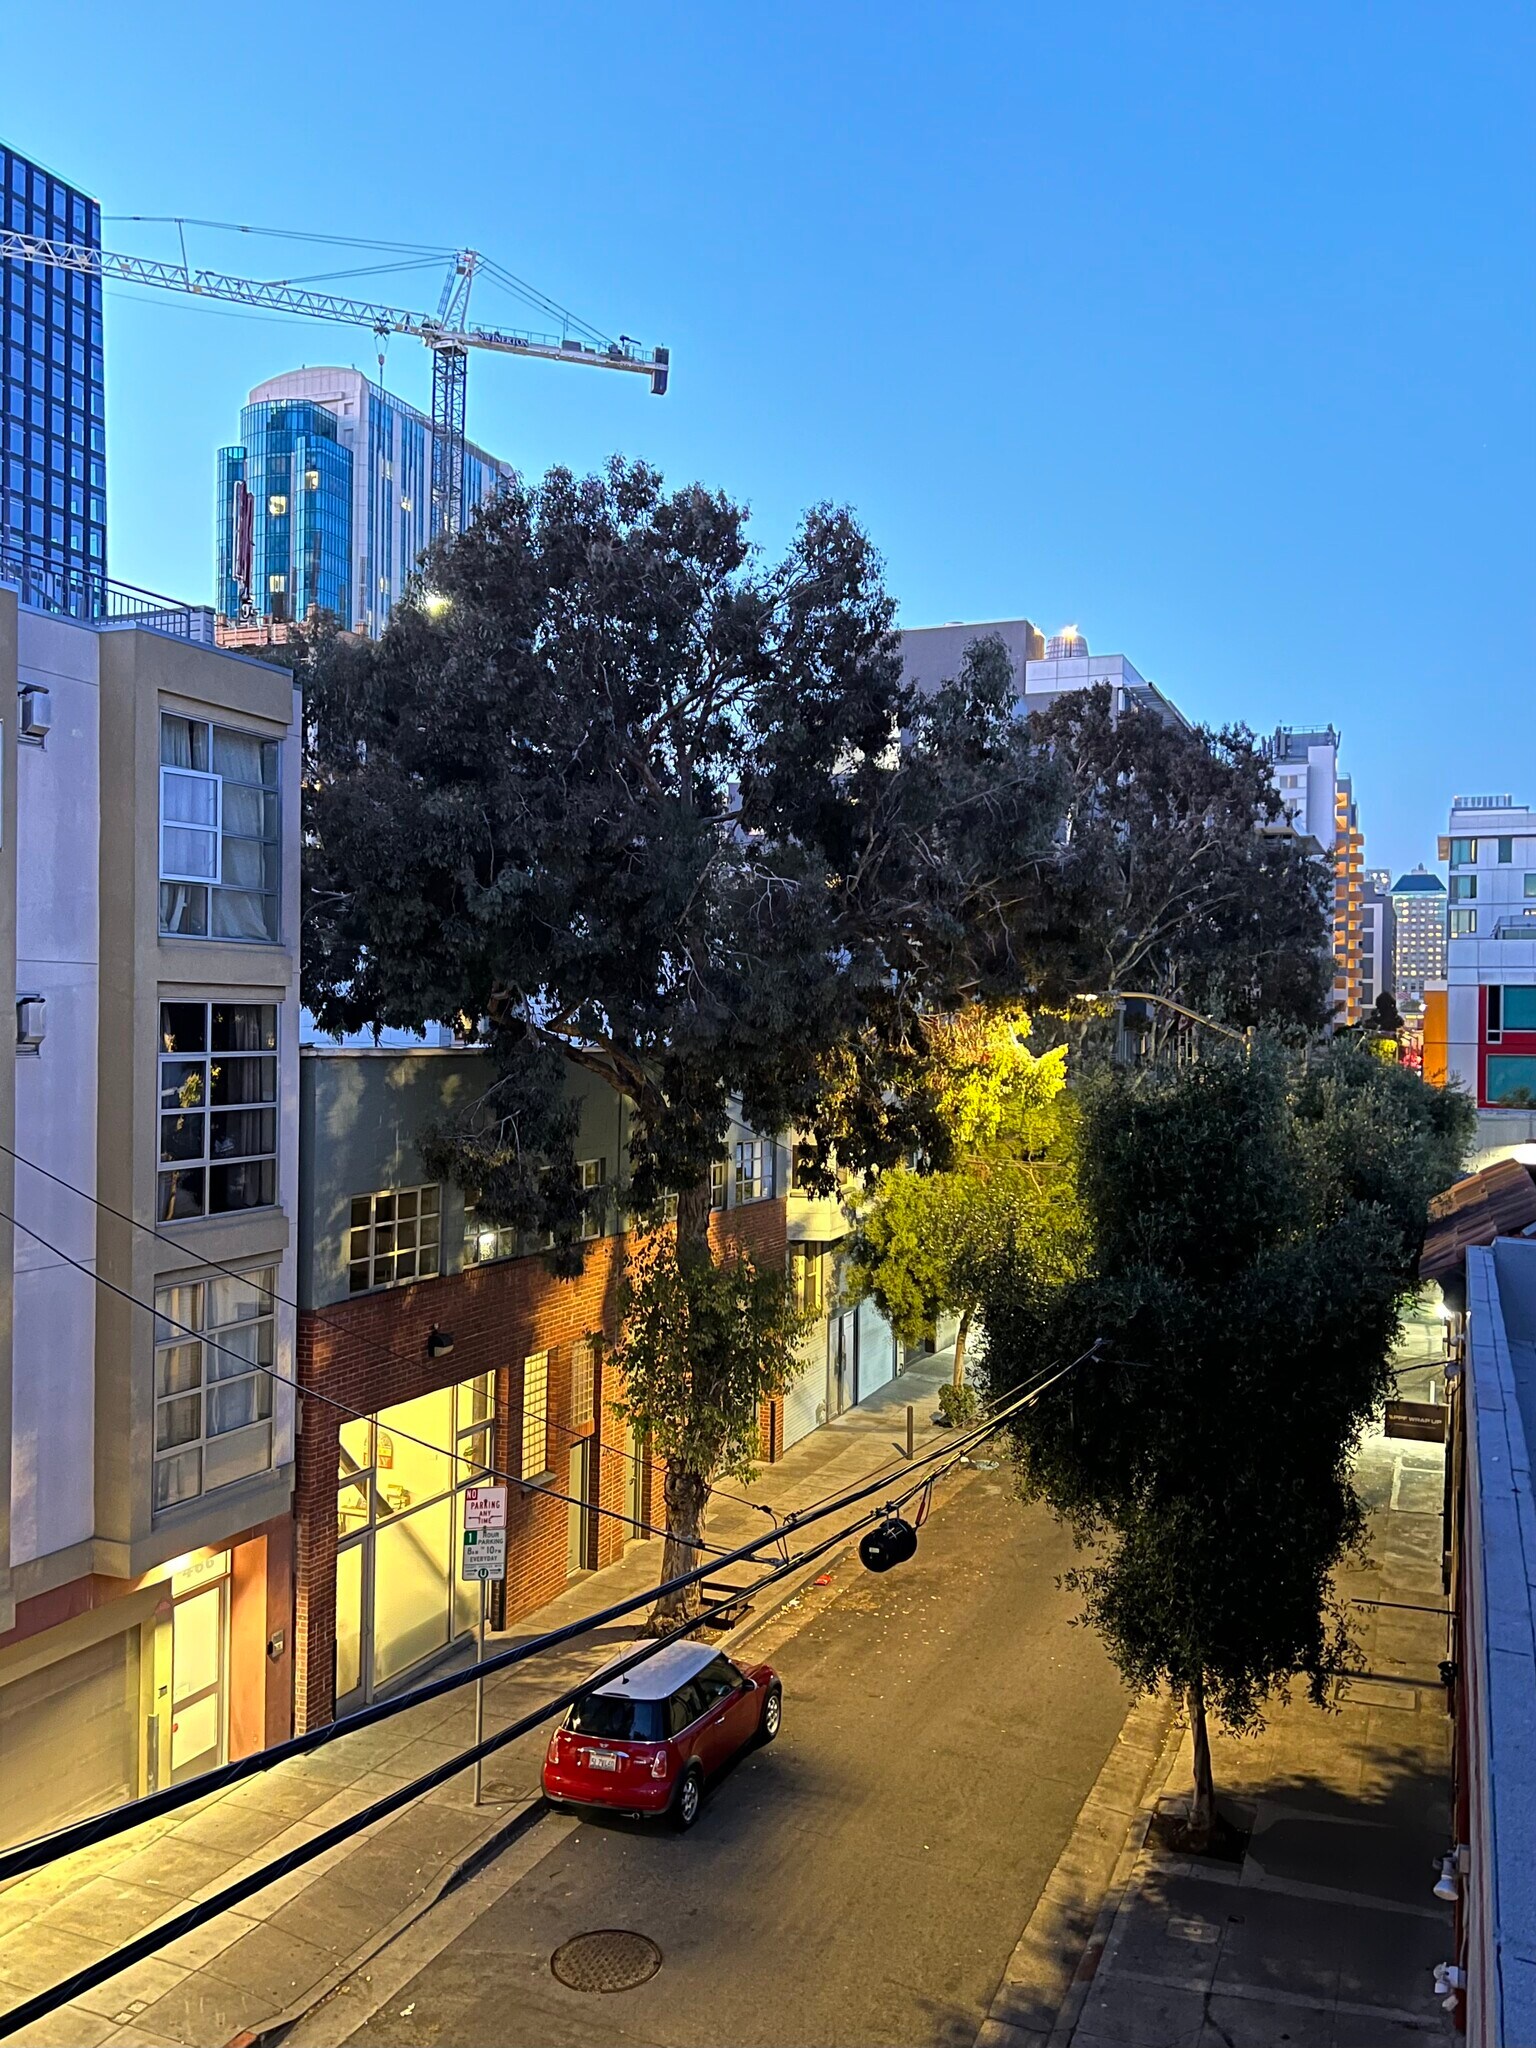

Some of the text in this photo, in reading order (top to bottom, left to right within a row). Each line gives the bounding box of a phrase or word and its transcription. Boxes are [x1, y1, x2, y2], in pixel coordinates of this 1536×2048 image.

[478, 332, 529, 347] SWINERTON
[1409, 1416, 1430, 1424] WRAP
[466, 1489, 477, 1499] NO
[471, 1500, 500, 1510] PARKING
